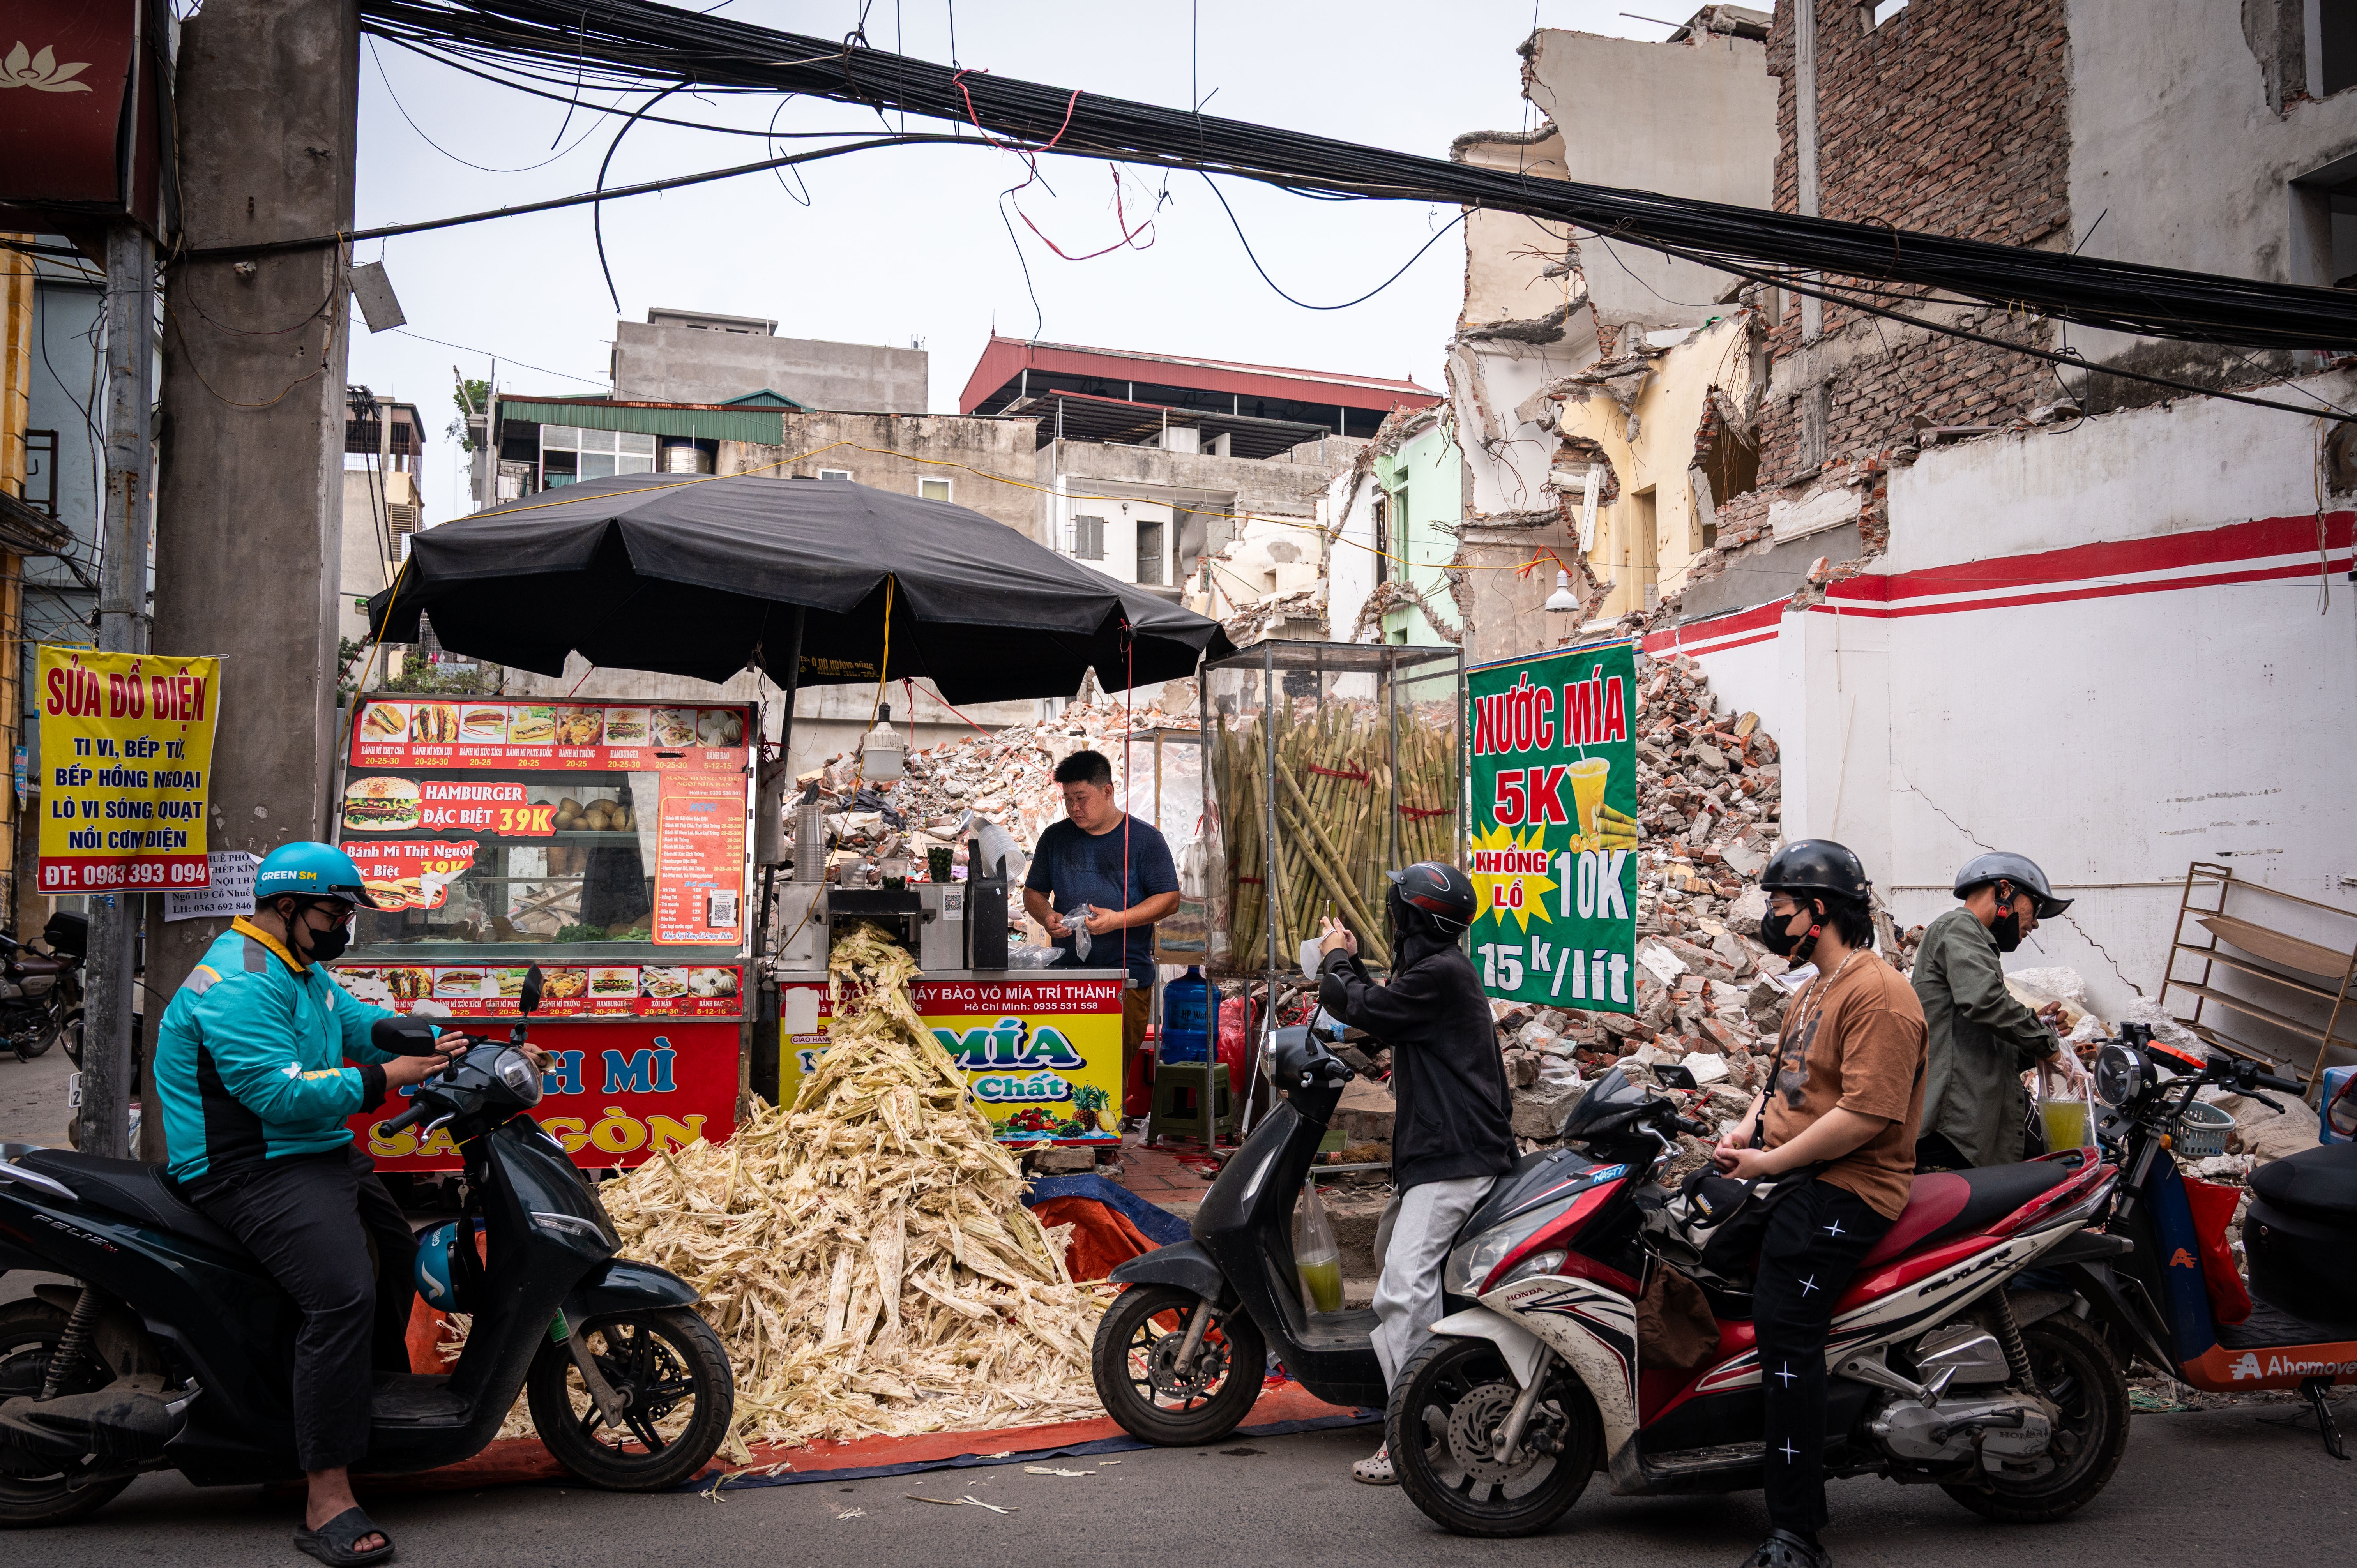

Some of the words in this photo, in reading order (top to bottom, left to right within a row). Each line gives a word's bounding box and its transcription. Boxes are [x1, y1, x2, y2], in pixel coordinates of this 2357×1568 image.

[46, 653, 101, 718] SỬA
[110, 658, 146, 720] ĐỒ
[152, 667, 207, 732] ĐIỆN
[1475, 671, 1555, 755] NƯỚC
[1563, 664, 1627, 747] MÍA
[74, 738, 90, 756] TI
[97, 739, 120, 760] VI,
[125, 735, 160, 758] BẾP
[165, 738, 185, 761] TỪ,
[361, 745, 375, 755] BÁNH
[376, 744, 382, 755] MÌ
[383, 747, 394, 757] THỊT
[395, 743, 405, 755] CHẢ
[412, 745, 426, 755] BÁNH
[426, 745, 433, 755] MÌ
[444, 747, 452, 758] LỤI
[459, 745, 473, 756] BÁNH
[474, 745, 480, 756] MÌ
[480, 746, 491, 756] XÚC
[491, 746, 503, 756] XÍCH
[506, 746, 519, 757] BÁNH
[520, 746, 526, 757] MÌ
[539, 745, 553, 757] RUỐC
[559, 747, 572, 758] BÁNH
[573, 747, 578, 758] MÌ
[579, 747, 595, 758] TRỨNG
[610, 750, 639, 759] HAMBURGER
[706, 750, 719, 759] BÁNH
[719, 751, 730, 760] BAO
[55, 763, 92, 787] BẾP
[99, 764, 148, 788] HỒNG
[154, 771, 201, 791] NGOẠI
[425, 785, 522, 801] HAMBURGER
[1493, 765, 1569, 826] 5K
[52, 796, 75, 819] LÒ
[81, 800, 99, 818] VI
[105, 797, 154, 821] SÓNG,
[157, 800, 203, 824] QUẠT
[689, 803, 717, 812] MENU
[423, 806, 456, 826] ĐẶC
[459, 807, 493, 829] BIỆT
[498, 808, 551, 831] 39K
[69, 826, 101, 849] NỒI
[108, 830, 144, 849] CƠM
[145, 826, 187, 852] ĐIỆN
[208, 853, 226, 862] HUÊ
[229, 852, 252, 862] PHÒ
[347, 846, 378, 857] Bánh
[383, 846, 399, 857] Mì
[404, 845, 430, 859] Thịt
[433, 845, 474, 859] Nguội
[45, 866, 76, 885] ĐT:
[83, 864, 125, 885] 0983
[129, 864, 164, 883] 393
[171, 863, 206, 882] 094
[261, 871, 297, 881] GREEN
[299, 871, 317, 880] SM
[374, 865, 400, 879] Biệt
[1475, 837, 1548, 874] KHỔNG
[1555, 849, 1628, 919] 10K
[216, 877, 233, 886] NỘI
[236, 875, 256, 884] THẤ
[173, 892, 191, 902] Ngõ
[211, 889, 224, 898] Cổ
[227, 888, 250, 897] Nhuế
[1493, 879, 1524, 909] LỒ
[194, 904, 214, 912] 0363
[942, 986, 975, 999] BÀO
[980, 986, 1001, 999] VỎ
[1006, 985, 1033, 999] MÍA
[1037, 985, 1060, 998] TRÍ
[1064, 984, 1116, 998] THÀNH
[451, 999, 457, 1008] MÌ
[500, 999, 506, 1007] MÌ
[557, 999, 562, 1007] MÌ
[662, 999, 672, 1008] MẶN
[1182, 1010, 1191, 1019] HP
[1194, 1010, 1207, 1021] Wat
[931, 1019, 1078, 1065] MÍA
[602, 1035, 677, 1094] MÌ
[977, 1074, 1064, 1097] Chất
[541, 1106, 707, 1152] GÒN
[1594, 1165, 1624, 1183] NASTY
[32, 1215, 108, 1245] FELIZ
[1506, 1287, 1544, 1301] HONDA
[2267, 1356, 2357, 1376] Ahamove
[1999, 1431, 2043, 1440] HONDA
